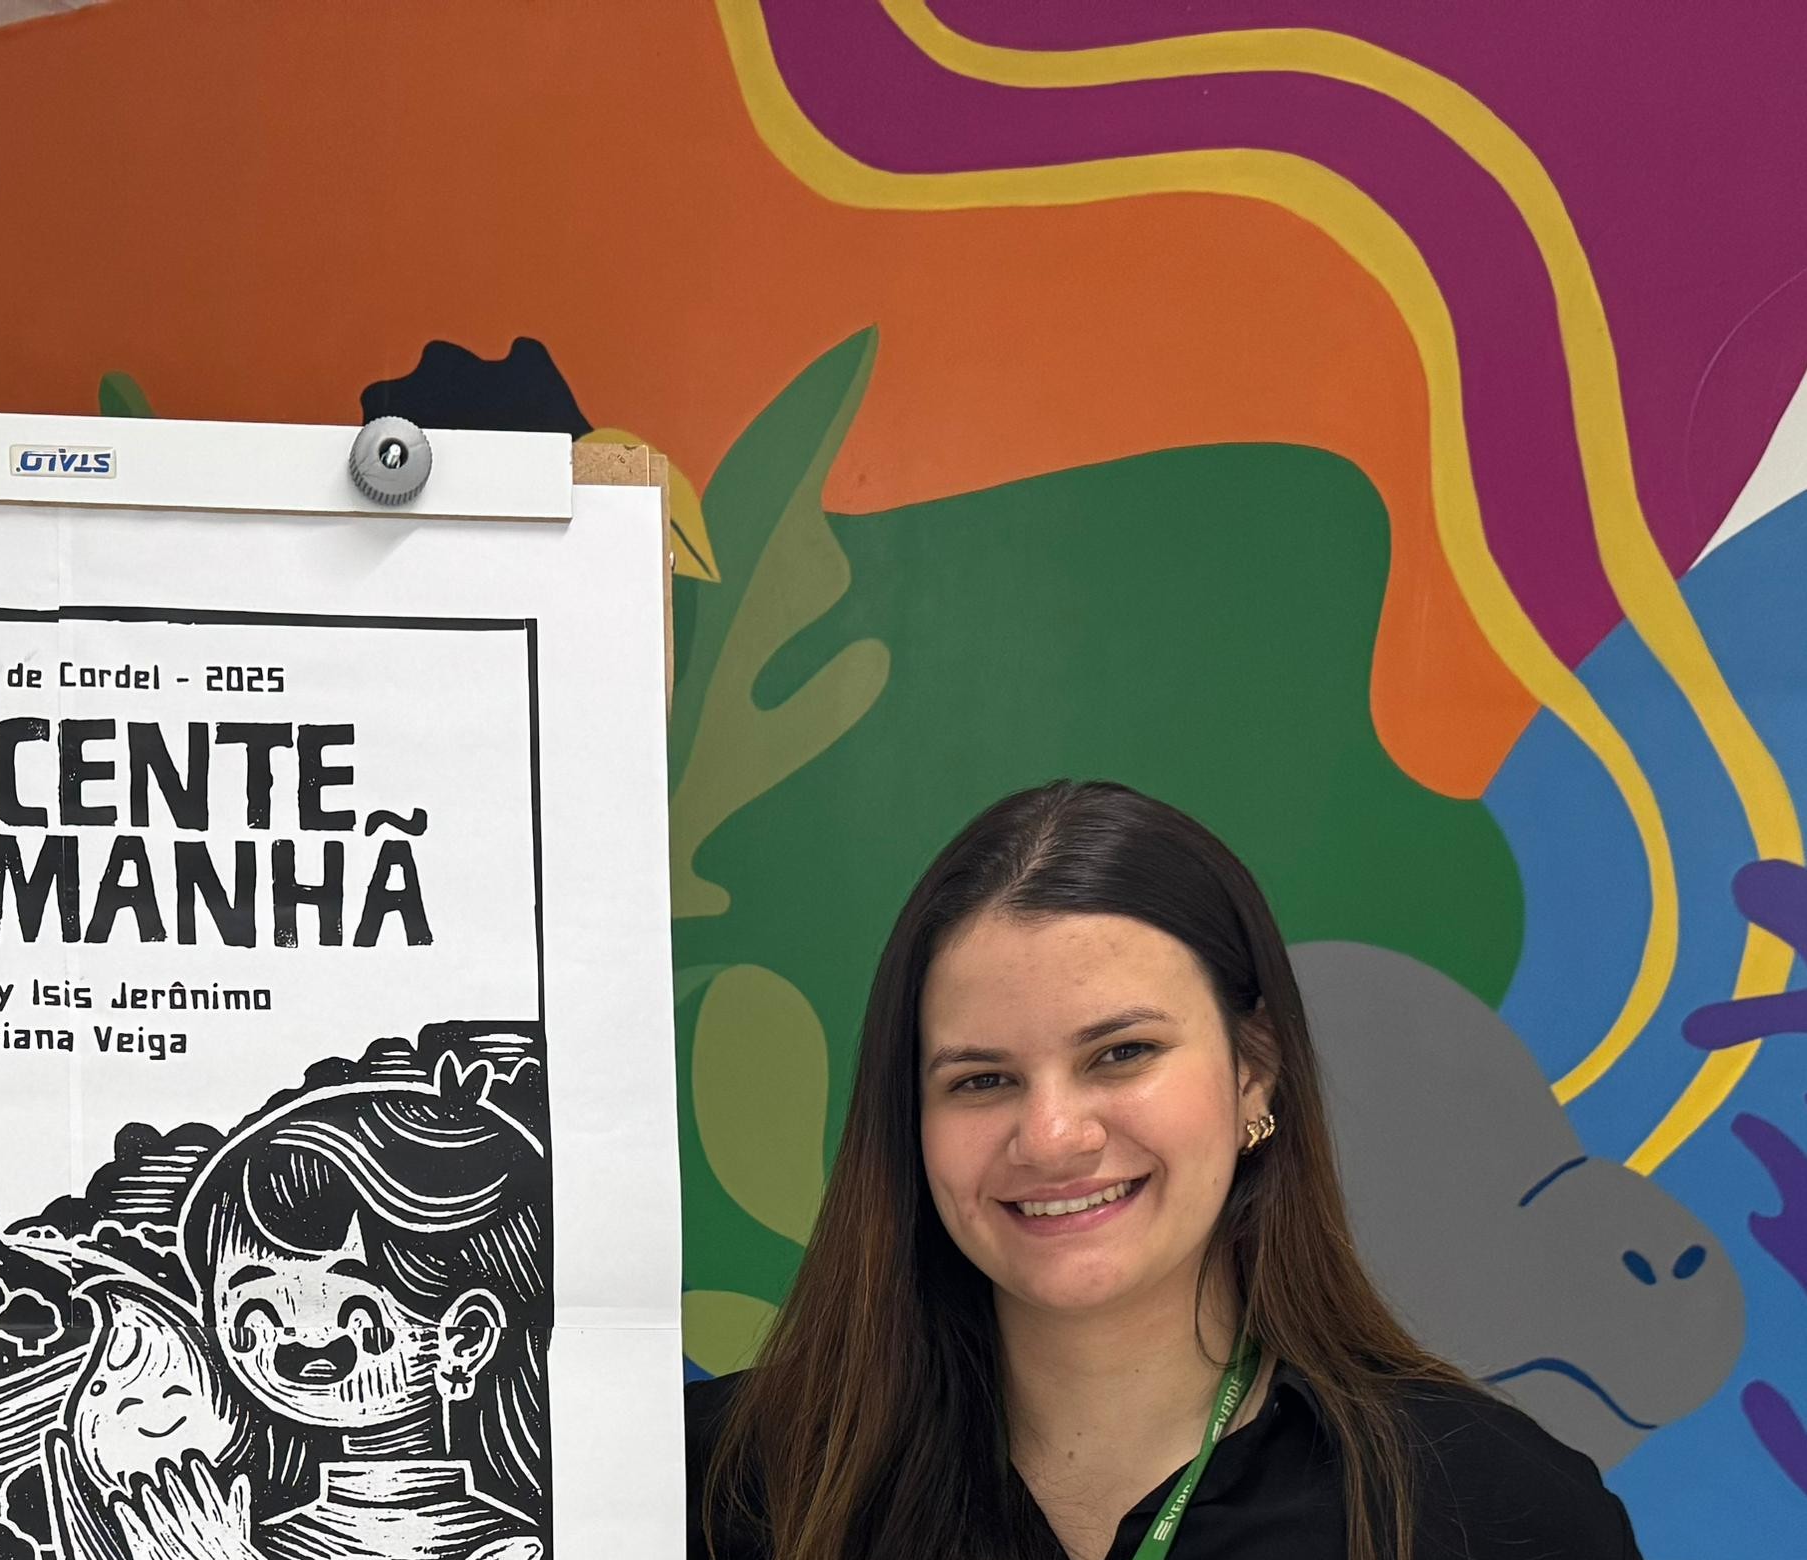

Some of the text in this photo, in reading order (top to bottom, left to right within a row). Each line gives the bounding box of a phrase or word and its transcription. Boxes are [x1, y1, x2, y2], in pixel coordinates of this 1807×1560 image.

[16, 450, 111, 473] STALO
[8, 663, 41, 688] de
[60, 662, 159, 689] Cordel
[206, 667, 283, 692] 2025
[33, 979, 92, 1008] Isis
[111, 982, 271, 1010] Jerônimo
[94, 1026, 186, 1060] Veiga
